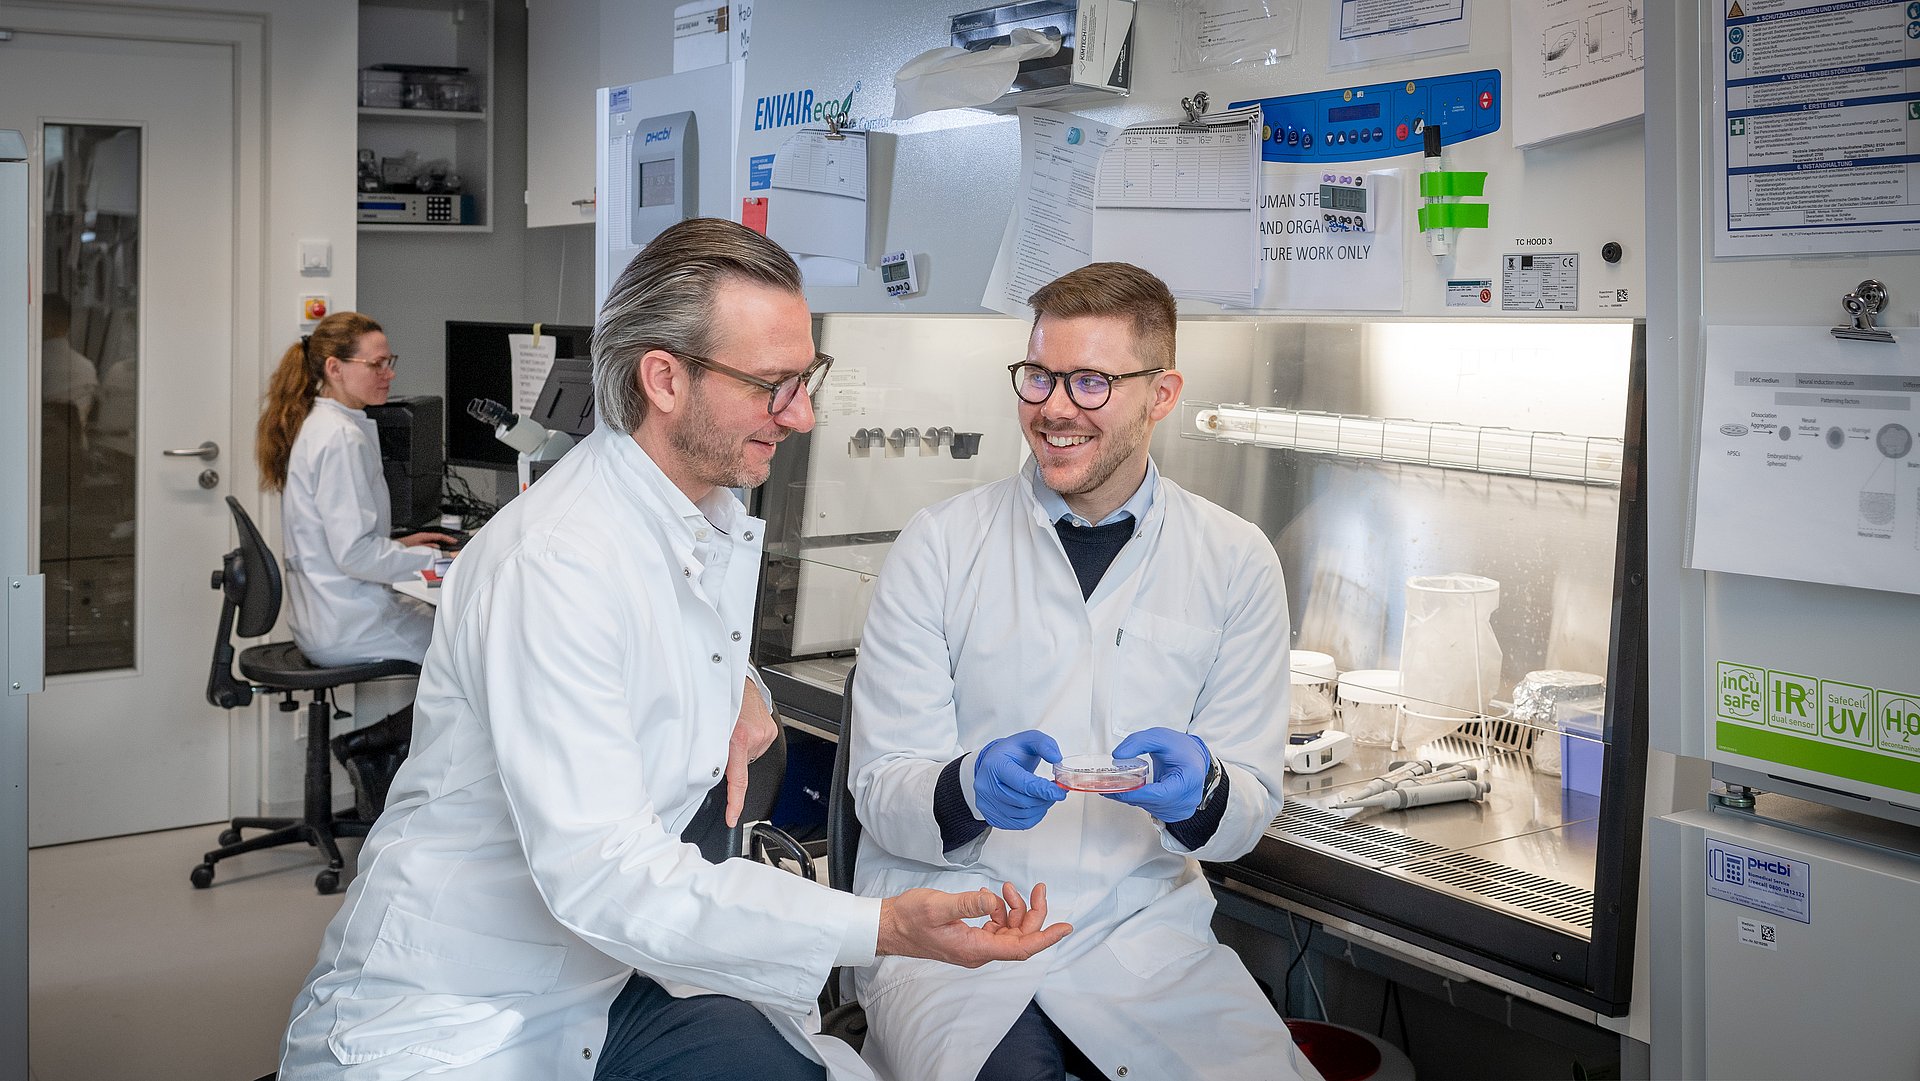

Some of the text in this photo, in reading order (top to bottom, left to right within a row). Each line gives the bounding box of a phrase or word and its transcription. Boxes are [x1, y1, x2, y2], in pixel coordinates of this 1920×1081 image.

[1787, 71, 1820, 80] VERHALTEN
[1830, 66, 1866, 75] STÖRUNGEN
[754, 89, 840, 131] ENVAIR eco
[1803, 161, 1852, 170] INSTANDHALTUNG
[1260, 193, 1319, 208] UMAN STE
[1296, 246, 1334, 260] WORK
[1338, 245, 1370, 260] ONLY
[1724, 672, 1759, 694] inCu
[1724, 694, 1760, 712] saFe
[1776, 680, 1807, 717] IR
[1828, 694, 1865, 709] SafeCell
[1771, 714, 1814, 729] dual sensor
[1829, 706, 1867, 738] UV
[1748, 872, 1789, 886] Biomedical Service
[1783, 887, 1804, 898] 1812122
